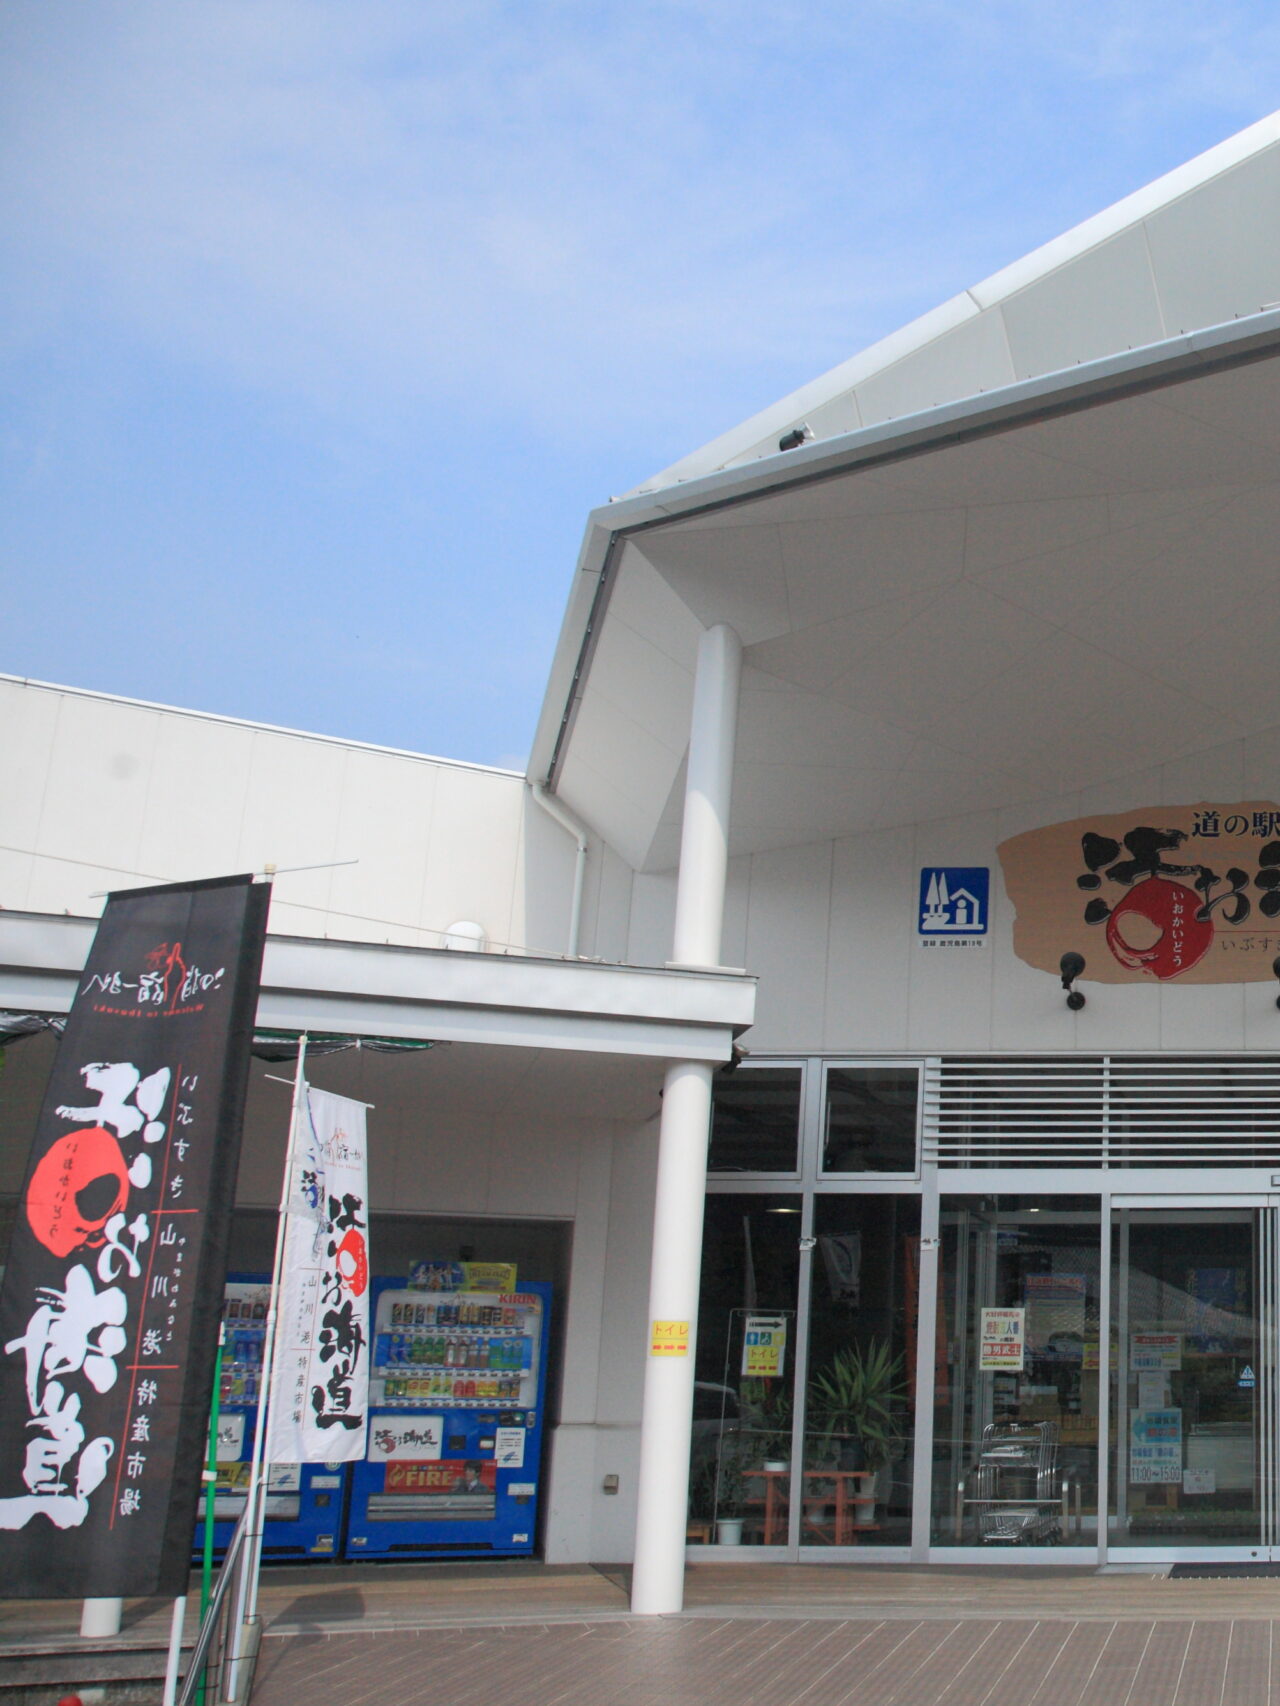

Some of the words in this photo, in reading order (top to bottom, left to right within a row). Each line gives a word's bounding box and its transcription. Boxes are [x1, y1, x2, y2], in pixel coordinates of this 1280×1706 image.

[1172, 890, 1185, 967] いおかいどう
[499, 1294, 538, 1304] KIRIN
[654, 1324, 689, 1336] トイレ
[750, 1349, 779, 1359] トイレ
[405, 1470, 455, 1487] FIRE
